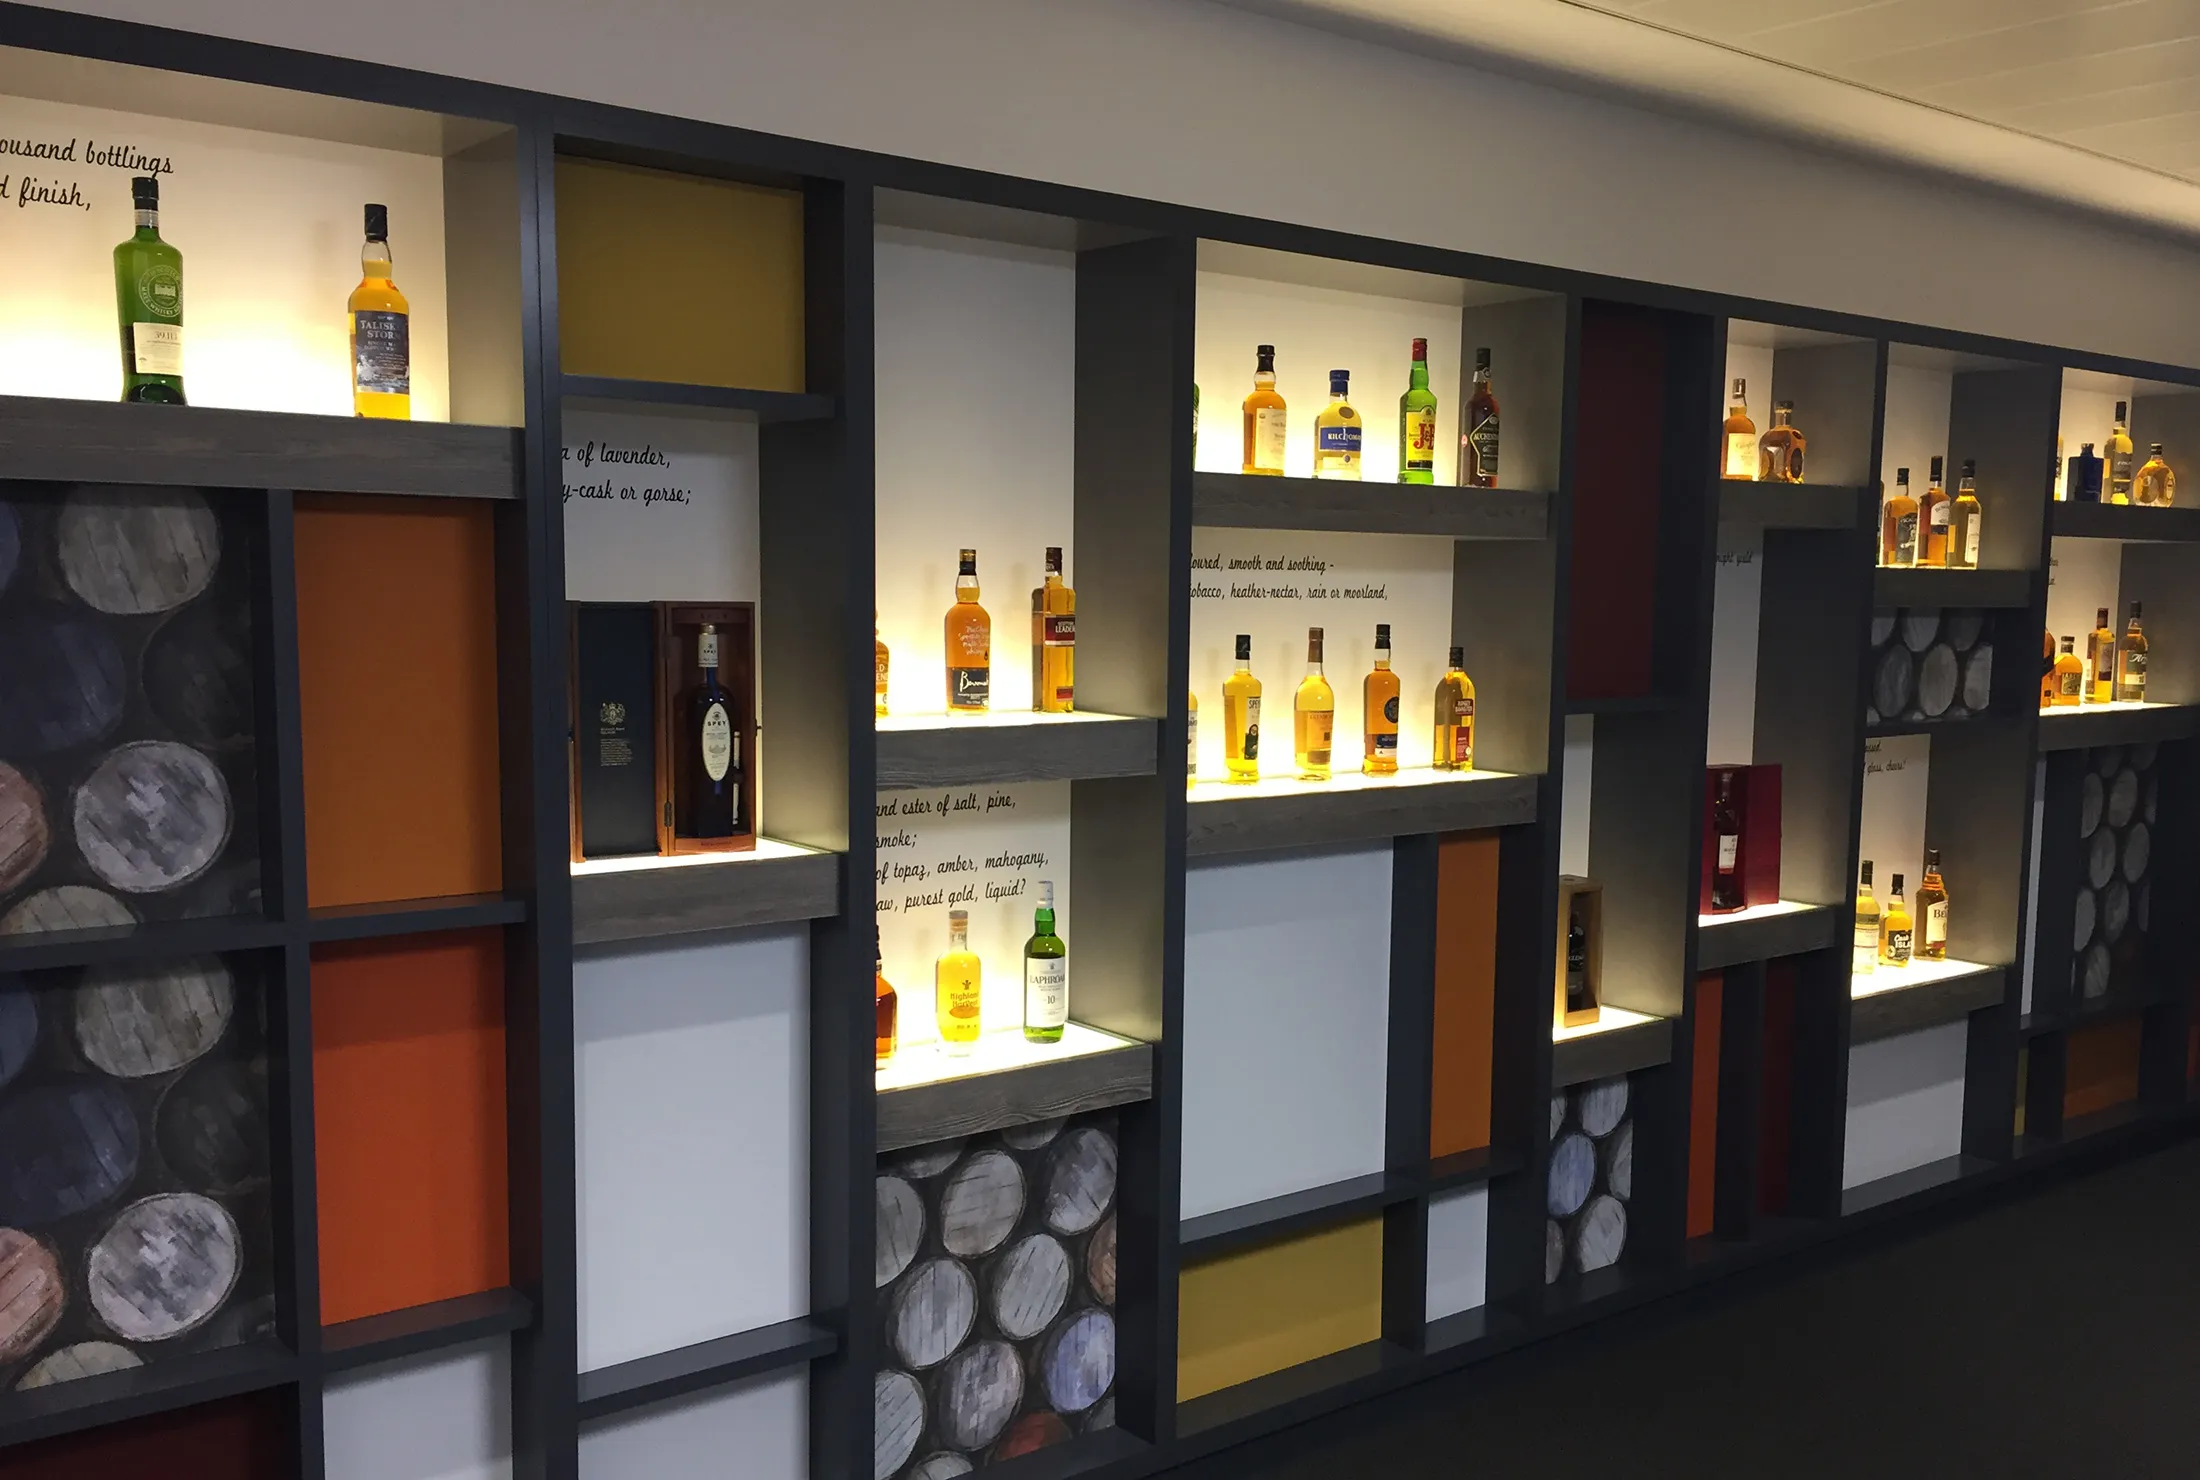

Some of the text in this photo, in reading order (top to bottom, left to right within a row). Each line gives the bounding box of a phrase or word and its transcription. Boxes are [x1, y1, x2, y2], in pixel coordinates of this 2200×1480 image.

[86, 140, 174, 179] bottlings
[18, 176, 91, 211] finish,
[577, 441, 594, 468] of
[600, 442, 670, 469] lavender,
[620, 486, 637, 500] or
[643, 487, 691, 507] gorse;
[1228, 555, 1262, 570] smooth
[1265, 555, 1285, 571] and
[1287, 556, 1326, 575] soothing
[1230, 583, 1302, 600] heather-nectar,
[1306, 584, 1327, 599] rain
[1330, 587, 1340, 599] or
[1344, 584, 1388, 600] moorland,
[876, 790, 1016, 817] and ester of salt, pine,
[876, 829, 917, 848] smoke;
[876, 850, 1049, 885] of topaz, amber, mahogany,
[876, 878, 1027, 913] aw, purest gold, liquid?
[1046, 995, 1056, 1005] 10
